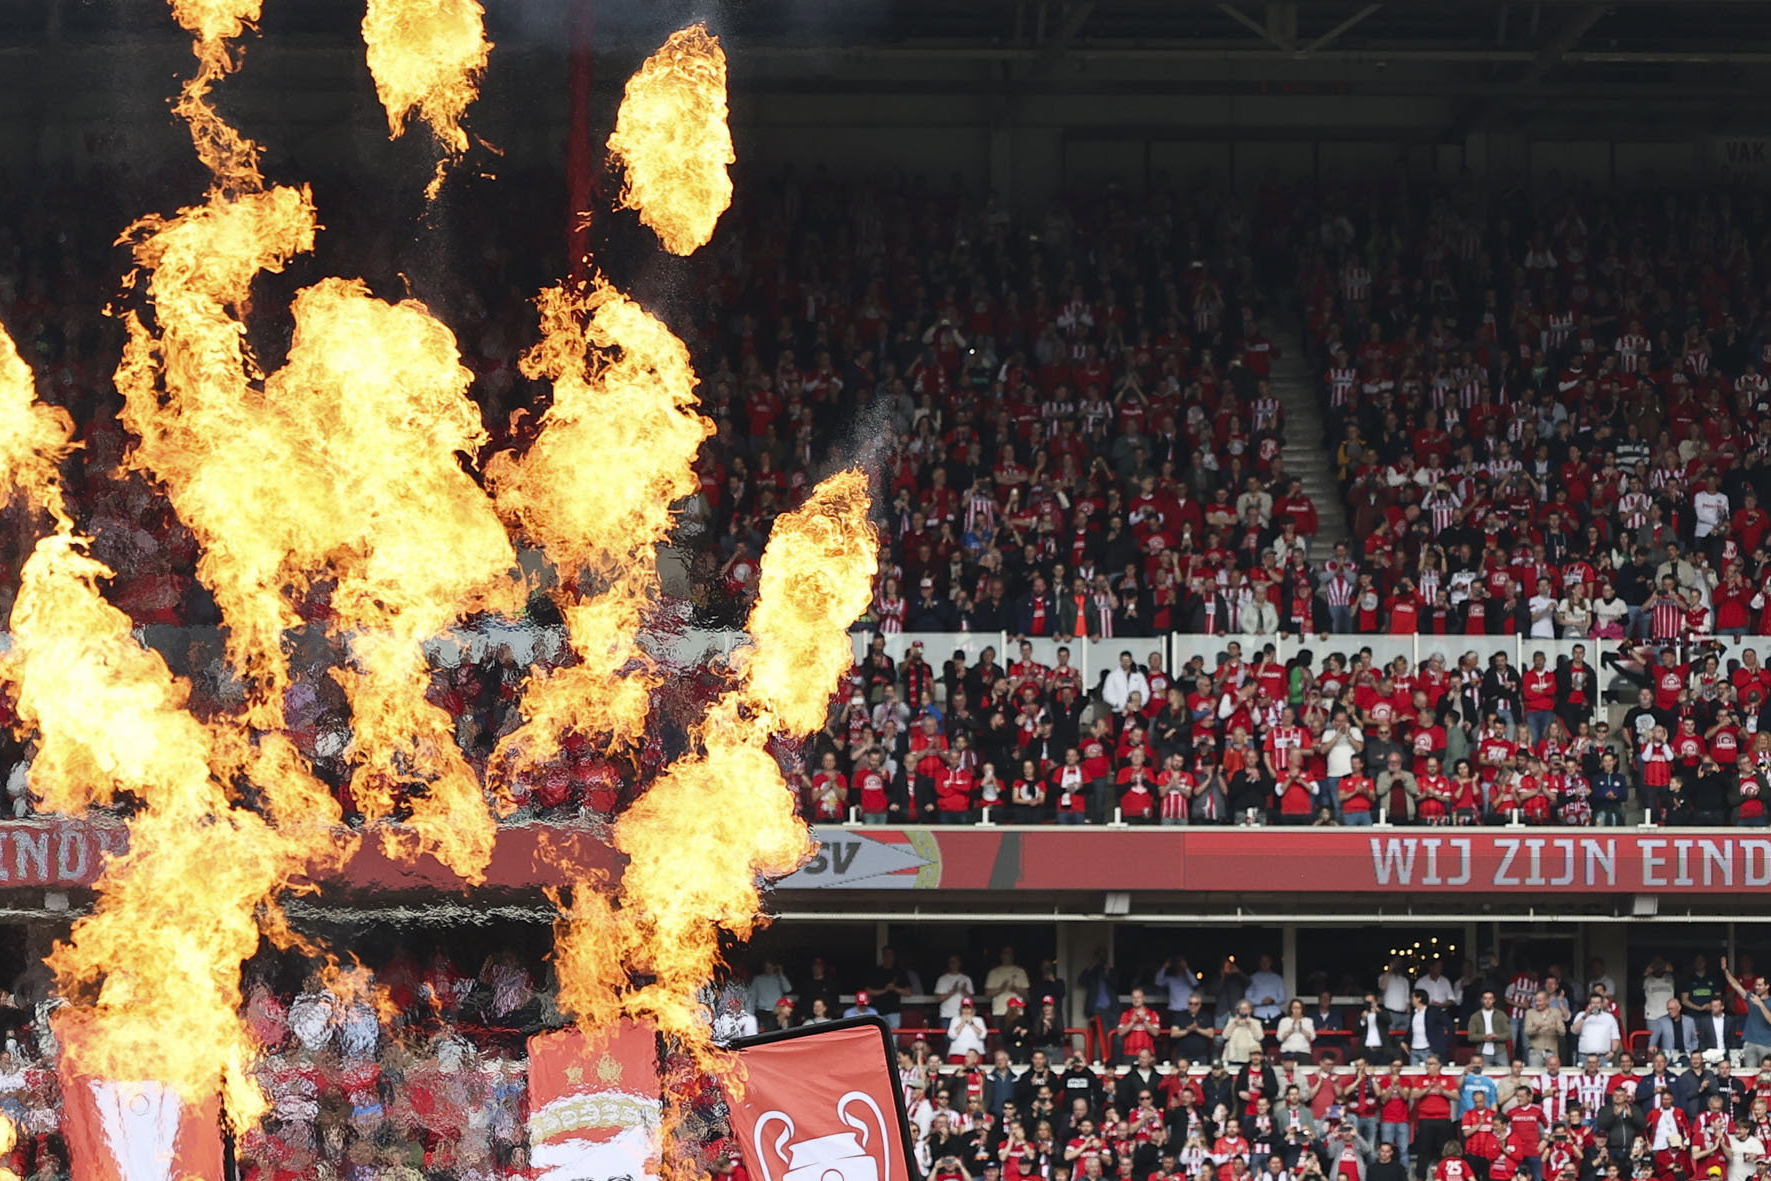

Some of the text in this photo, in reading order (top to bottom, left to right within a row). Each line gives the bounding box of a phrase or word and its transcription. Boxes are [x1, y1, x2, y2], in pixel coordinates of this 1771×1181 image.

[804, 842, 862, 875] SV
[1370, 838, 1472, 886] WIJ
[1493, 838, 1618, 887] ZIJN
